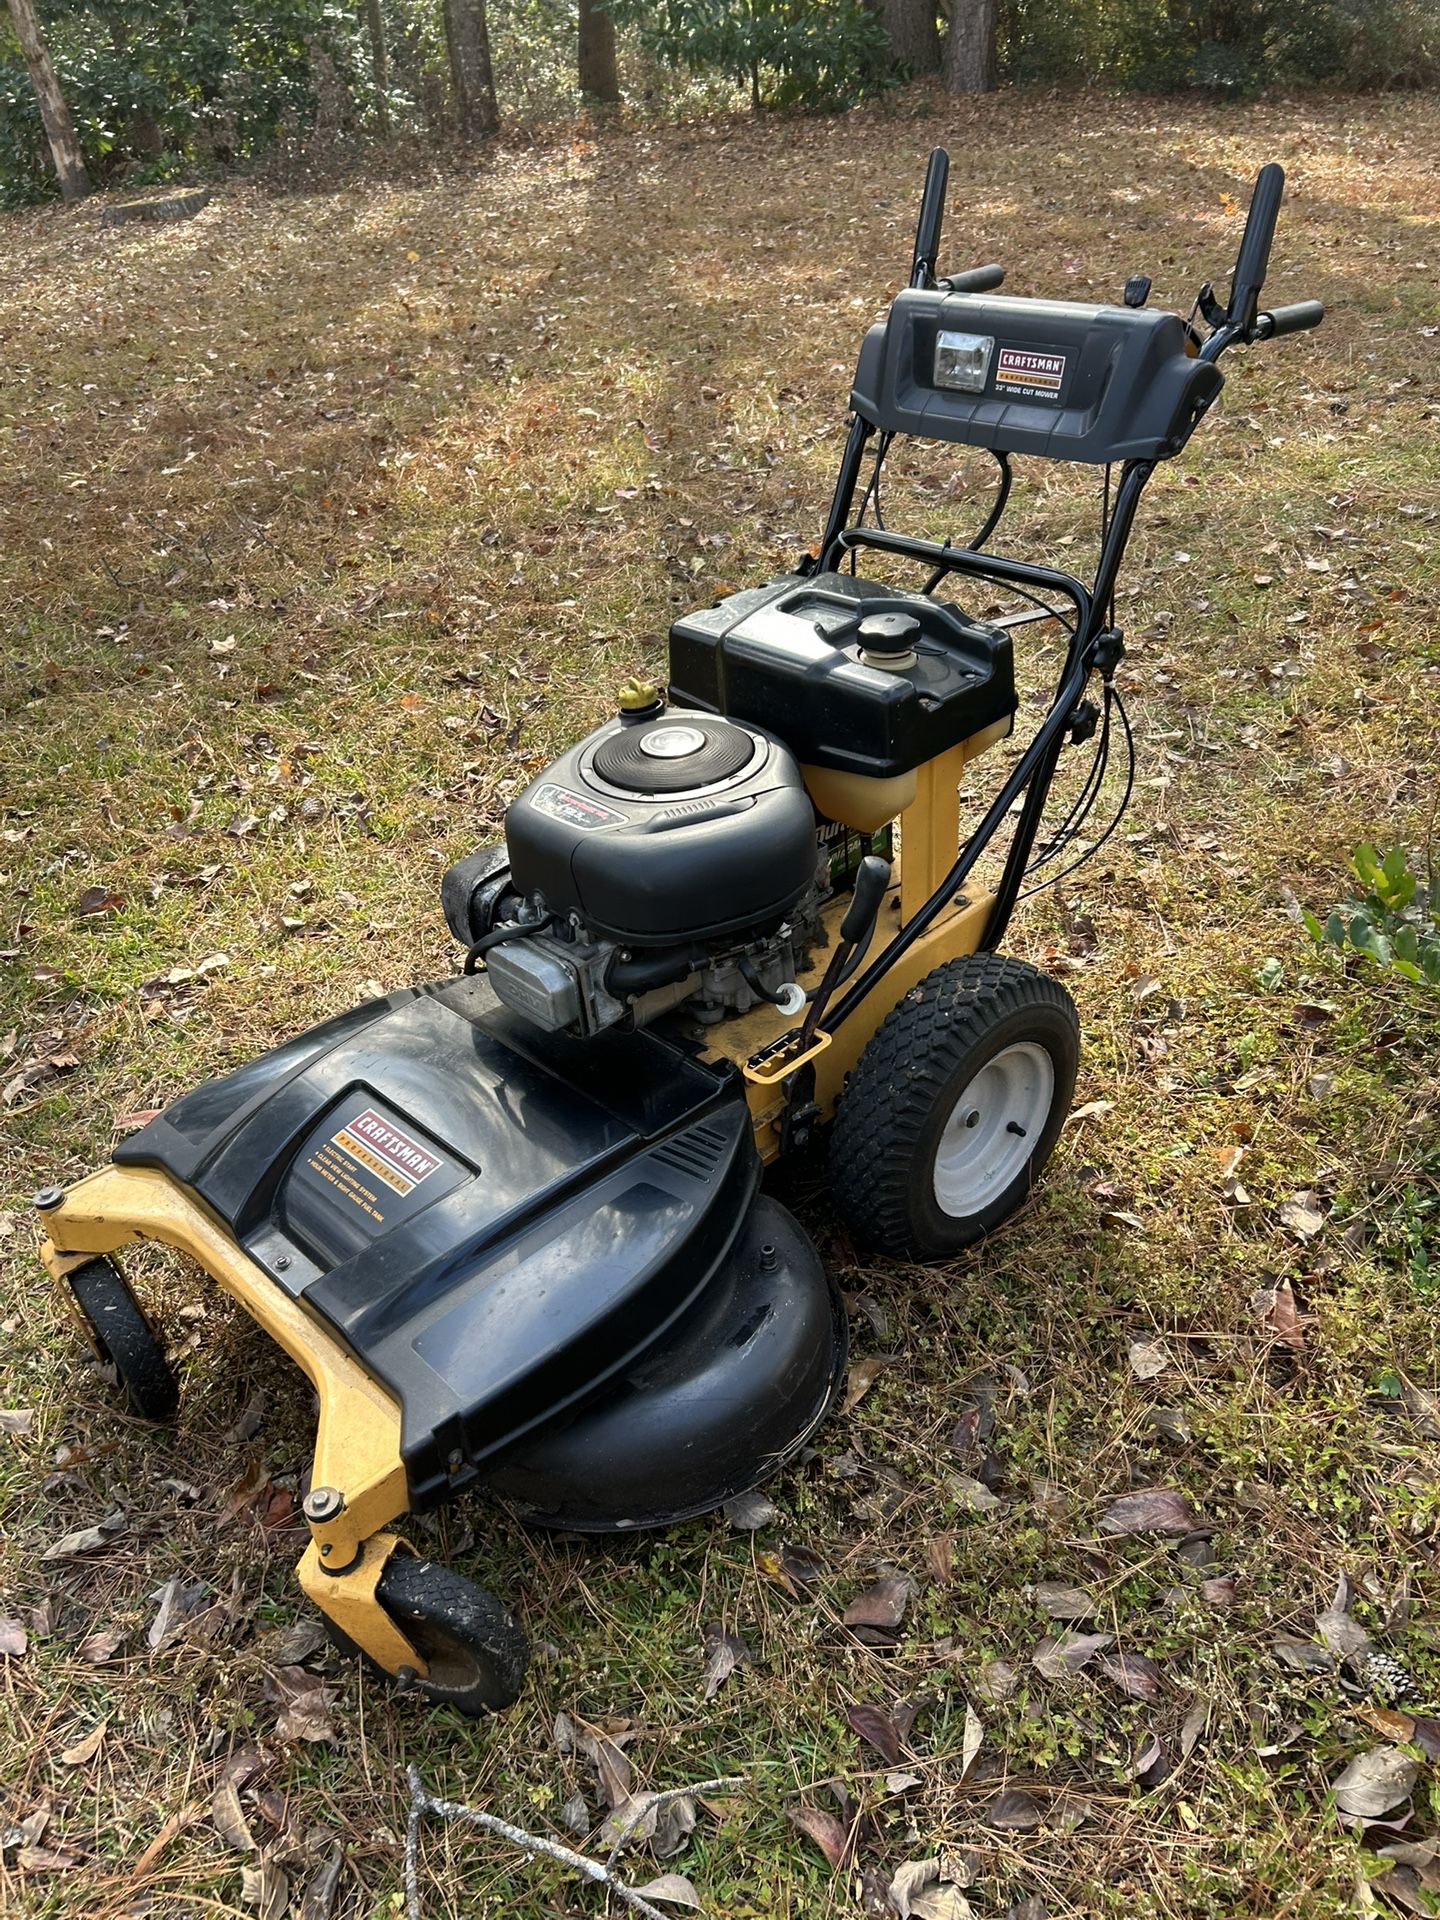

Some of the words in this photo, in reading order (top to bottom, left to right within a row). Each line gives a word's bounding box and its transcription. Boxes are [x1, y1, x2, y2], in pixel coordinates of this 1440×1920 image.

[1003, 355, 1060, 371] CRAFTSMAN
[1006, 386, 1021, 394] WIDE
[1034, 390, 1059, 399] MOWER
[325, 1145, 345, 1163] ELECTRIC
[342, 1160, 358, 1173] START
[339, 1136, 406, 1190] PROFESSIONAL
[357, 1117, 431, 1173] CRAFTSMAN
[310, 1160, 323, 1172] HOUR
[320, 1168, 336, 1183] METER
[348, 1191, 364, 1206] GAUGE
[361, 1202, 373, 1214] FUEL
[371, 1210, 385, 1223] TANK
[317, 1153, 332, 1166] CLEAR
[330, 1163, 342, 1175] VIEW
[340, 1172, 361, 1189] LIGHTING
[358, 1186, 378, 1203] SYSTEM
